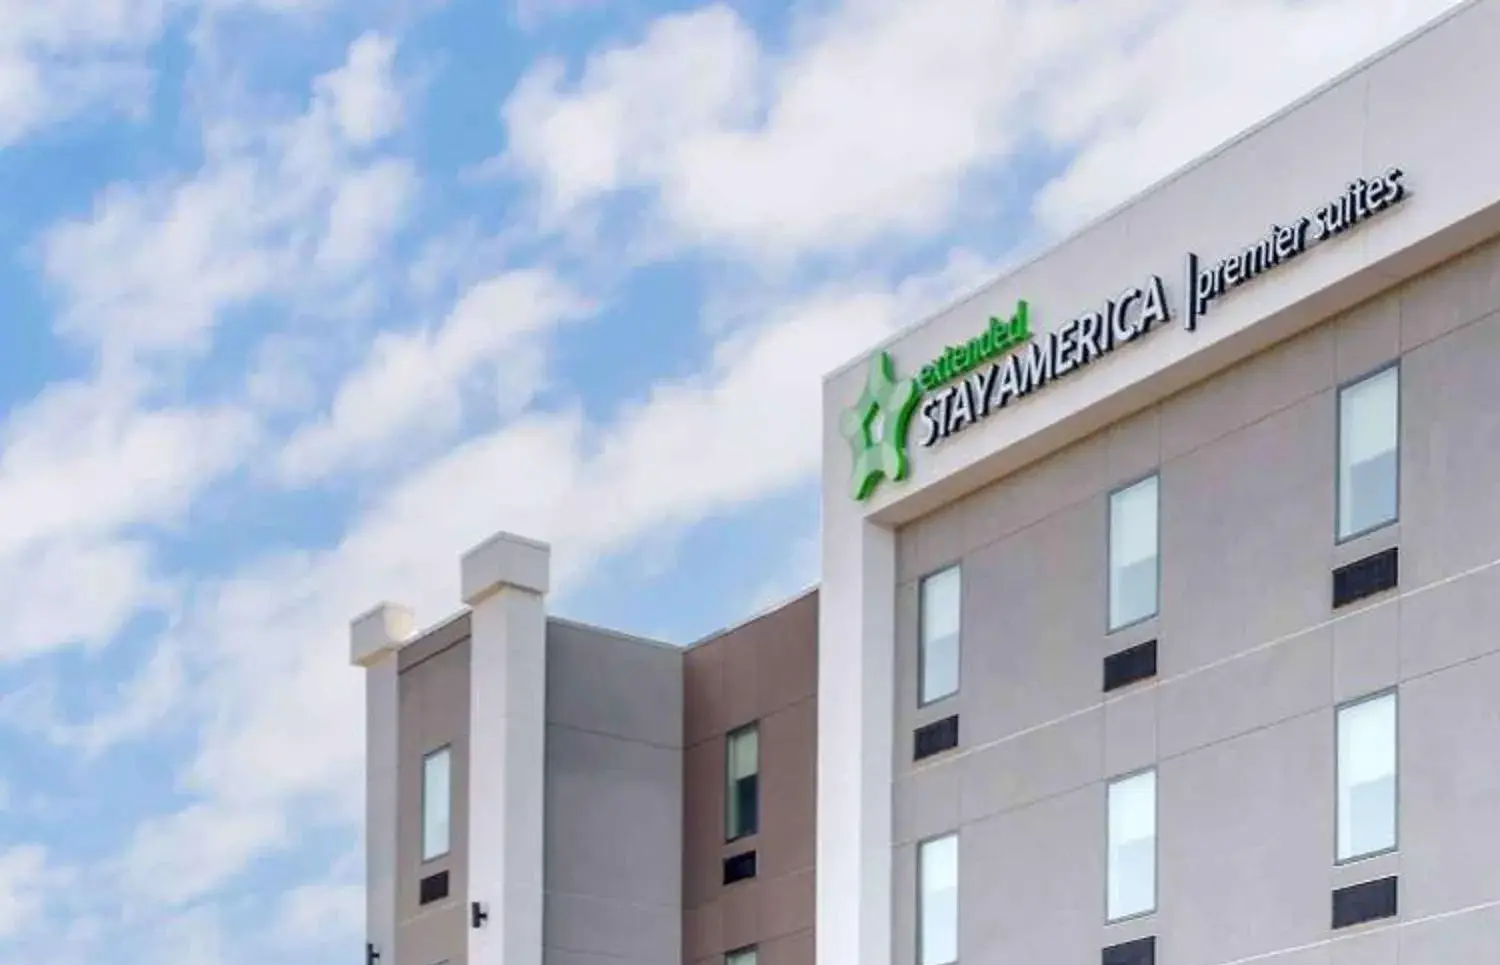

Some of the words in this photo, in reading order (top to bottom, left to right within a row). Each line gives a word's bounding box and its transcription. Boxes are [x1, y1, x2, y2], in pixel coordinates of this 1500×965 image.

[1195, 217, 1311, 316] premier
[1312, 166, 1404, 241] suites
[919, 299, 1032, 390] extended
